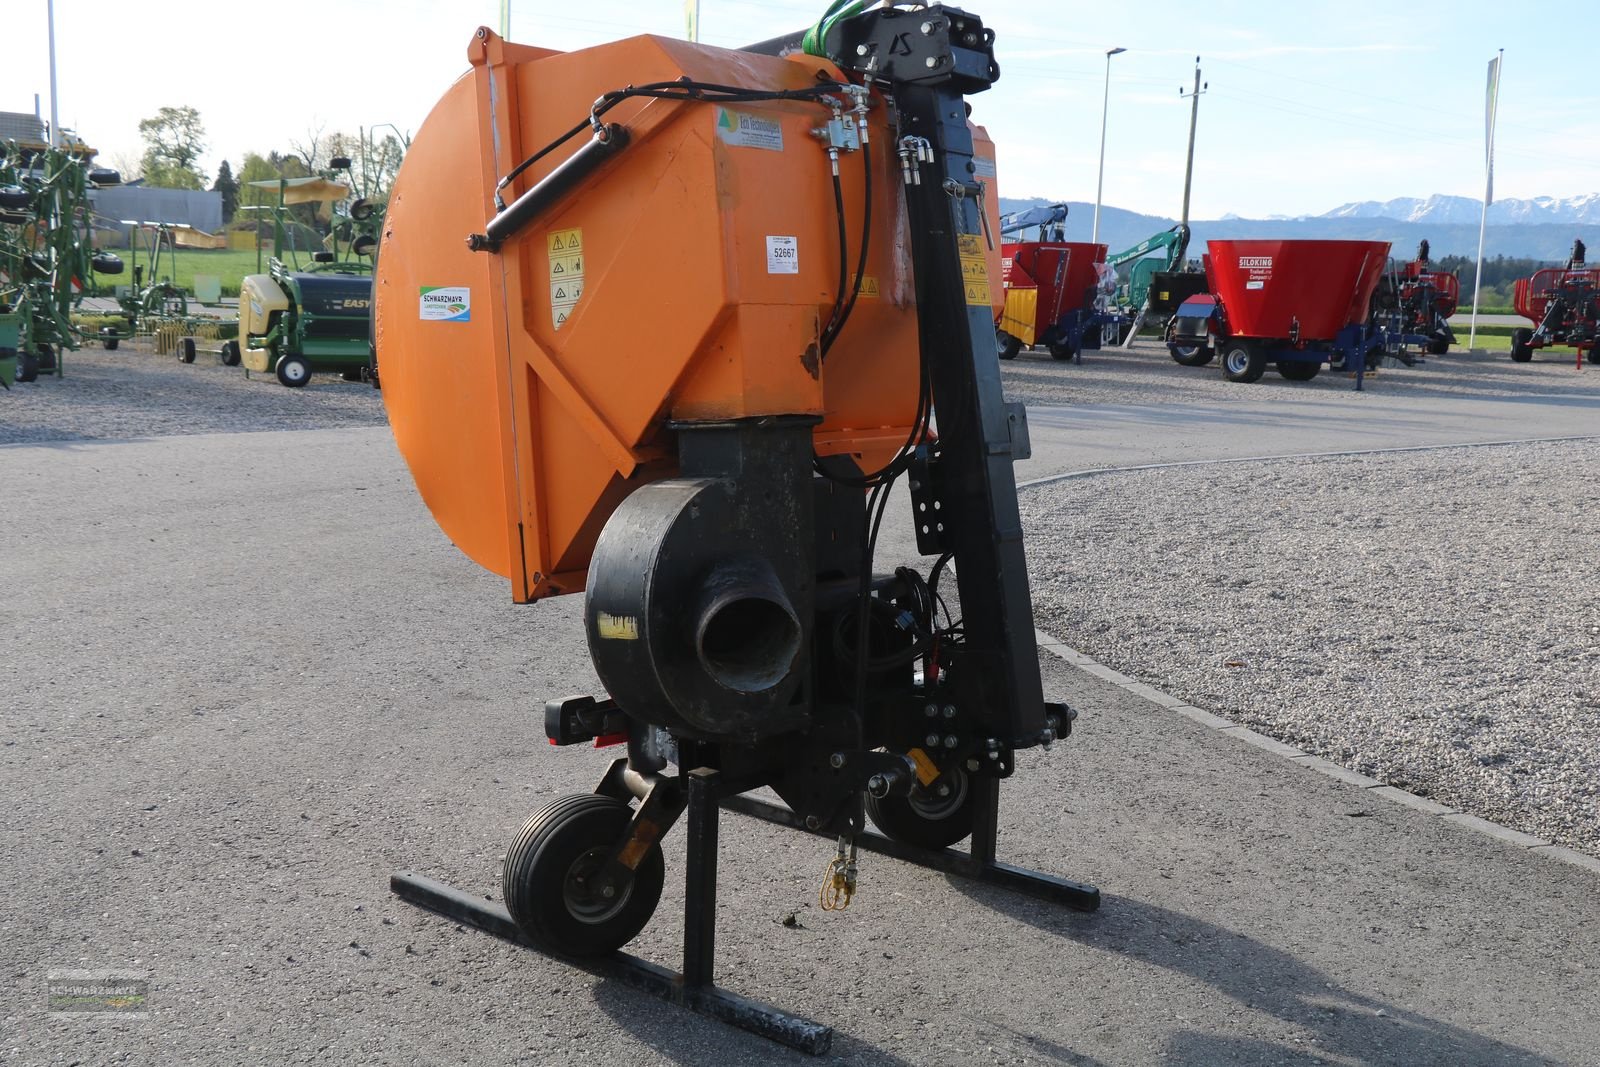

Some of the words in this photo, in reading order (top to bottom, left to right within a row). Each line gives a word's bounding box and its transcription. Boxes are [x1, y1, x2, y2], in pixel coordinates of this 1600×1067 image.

[774, 247, 795, 258] 52667
[1239, 258, 1272, 266] SILOKING
[423, 294, 463, 303] SCHWARZMAYR
